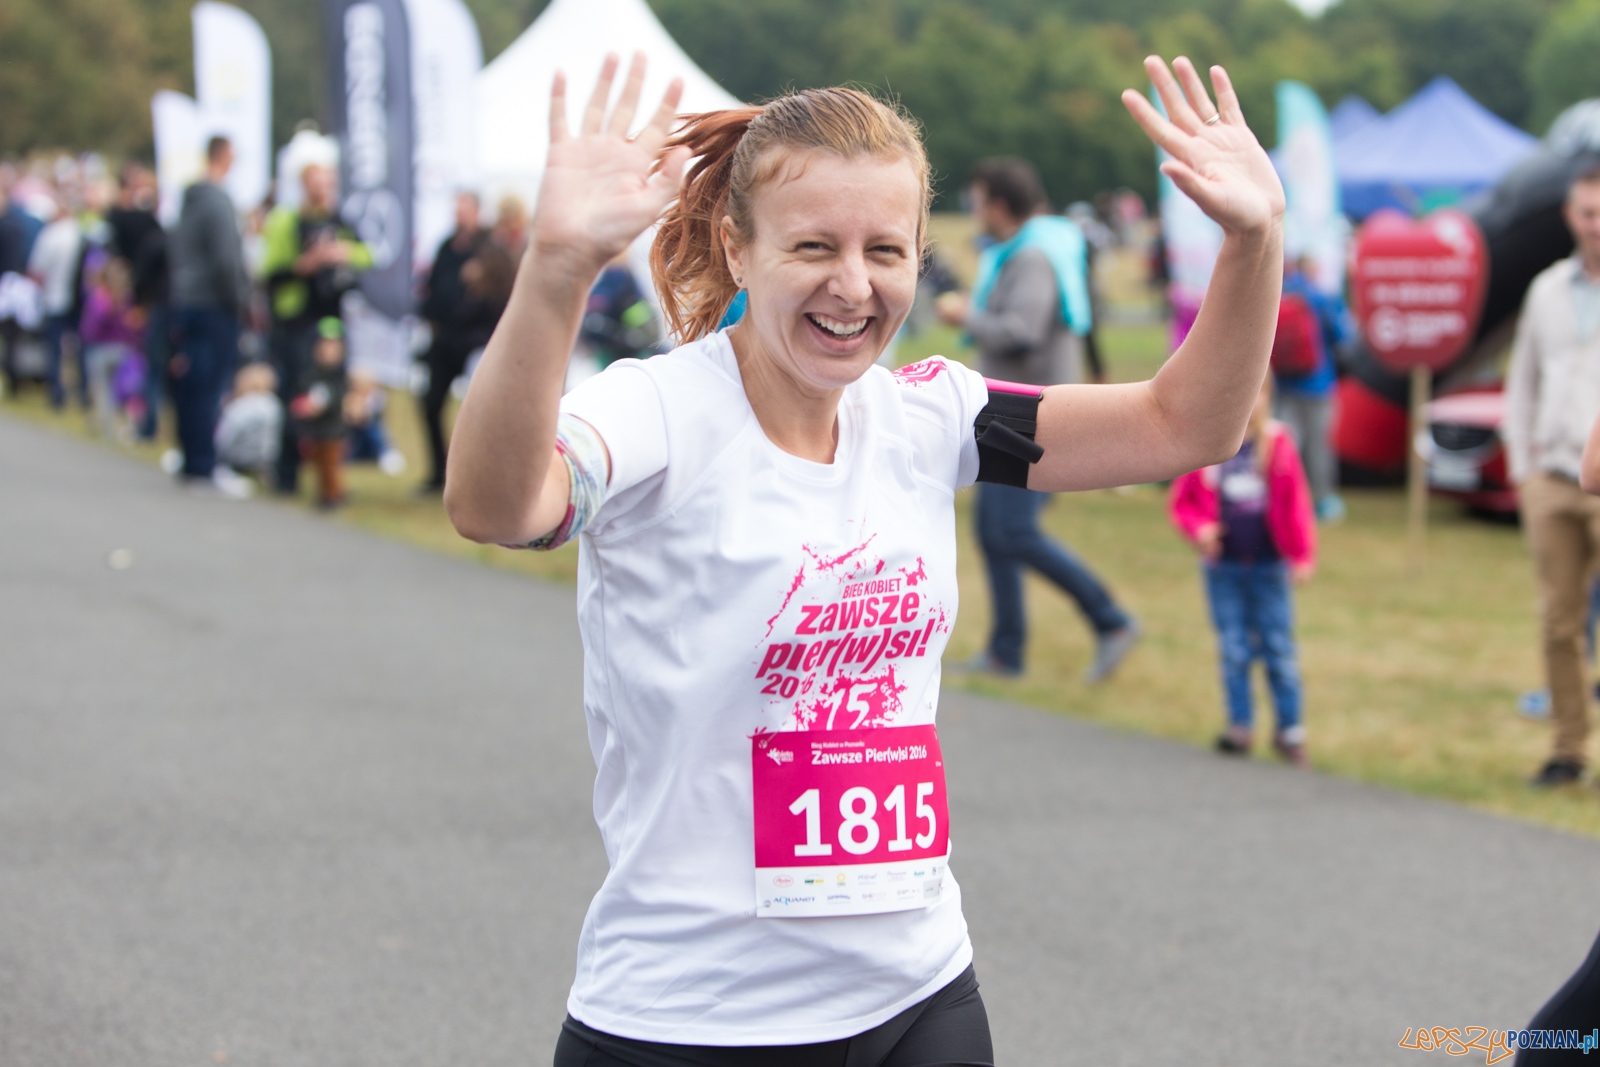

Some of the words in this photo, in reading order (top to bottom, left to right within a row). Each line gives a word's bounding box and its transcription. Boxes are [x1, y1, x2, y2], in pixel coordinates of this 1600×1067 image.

[842, 582, 864, 600] BIEG
[864, 578, 902, 596] KOBIET
[794, 591, 920, 636] zawsze
[760, 672, 817, 699] 2016
[811, 749, 864, 765] Zawsze
[865, 746, 908, 764] Pier(w)si
[908, 744, 928, 760] 2016
[788, 781, 937, 857] 1815
